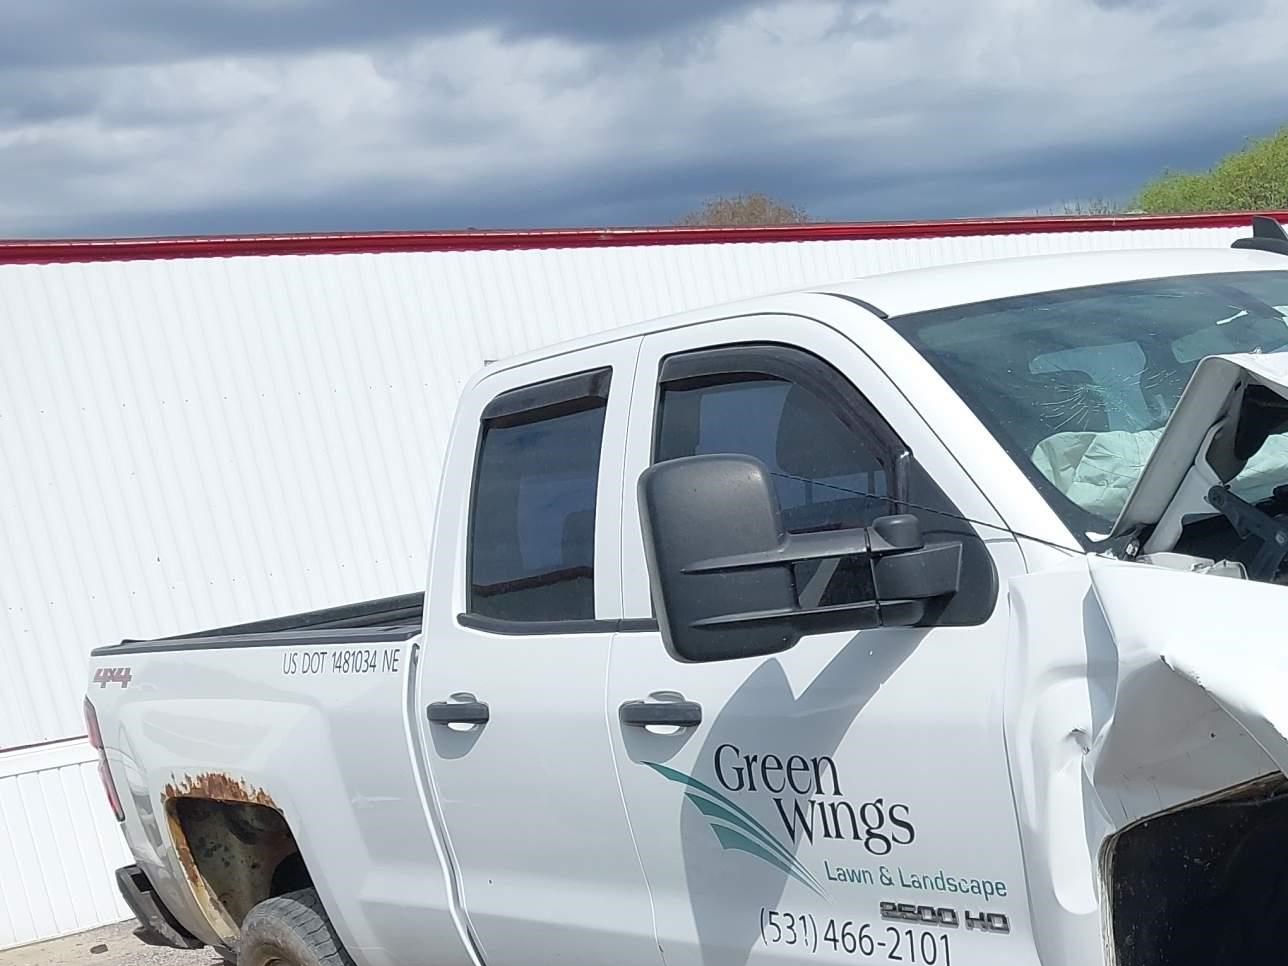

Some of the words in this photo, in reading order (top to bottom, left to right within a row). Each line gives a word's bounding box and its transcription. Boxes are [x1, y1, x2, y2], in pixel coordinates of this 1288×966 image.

[283, 653, 299, 674] US
[302, 652, 327, 674] DOT
[331, 650, 377, 673] 1481034
[382, 650, 400, 672] NE
[714, 743, 843, 796] Green
[774, 798, 915, 855] Wings
[824, 861, 874, 886] Lawn
[879, 866, 895, 886] &
[898, 867, 1007, 900] Landscape
[760, 907, 818, 953] (531)
[880, 901, 958, 929] 2500
[965, 910, 1010, 934] HD
